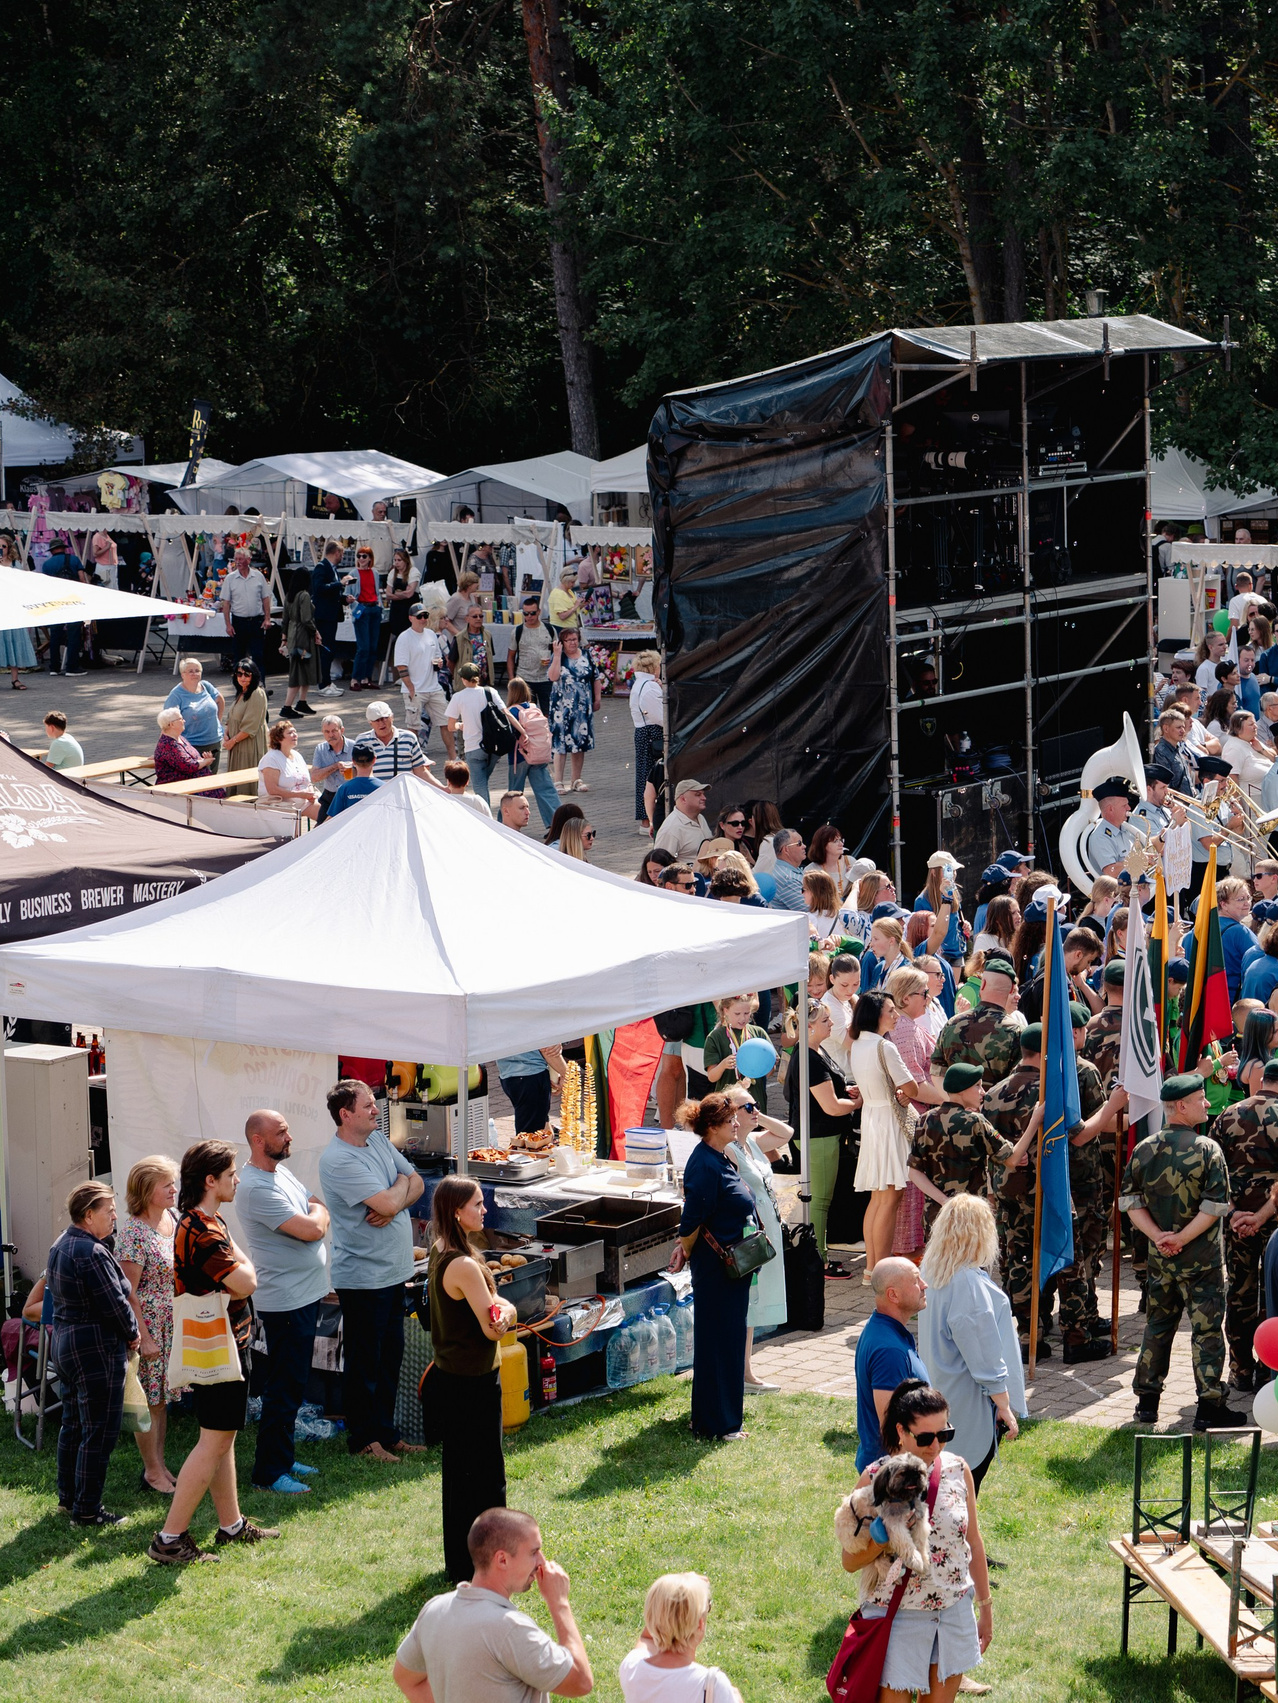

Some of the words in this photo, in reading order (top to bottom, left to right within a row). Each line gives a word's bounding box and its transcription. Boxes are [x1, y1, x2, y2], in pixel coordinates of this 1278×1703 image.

[0, 783, 89, 815] LDA
[0, 902, 12, 924] LY
[20, 892, 72, 921] BUSINESS
[80, 885, 125, 911] BREWER
[132, 880, 186, 904] MASTERY
